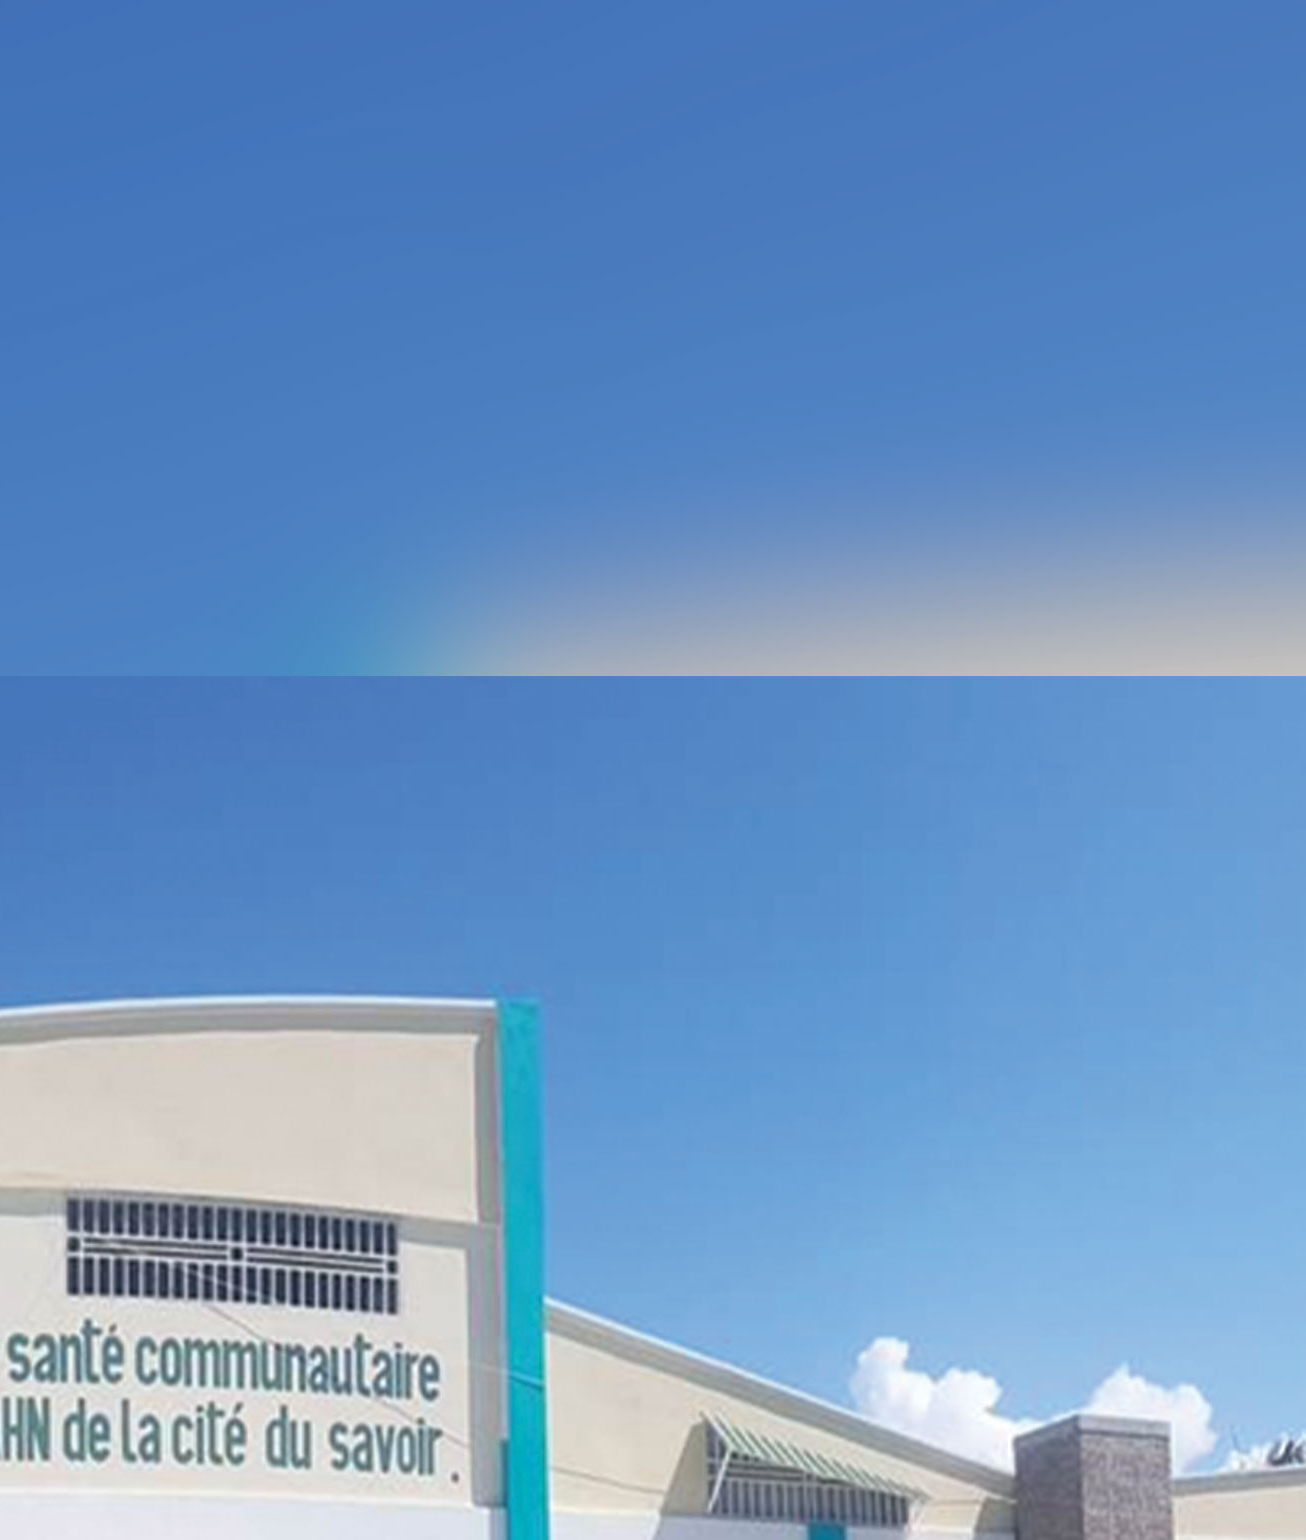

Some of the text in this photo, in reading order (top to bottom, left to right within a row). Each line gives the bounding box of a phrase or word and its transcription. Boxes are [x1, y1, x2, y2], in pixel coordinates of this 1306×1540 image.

[7, 1318, 125, 1383] santé
[134, 1335, 441, 1402] communautaire
[63, 1398, 111, 1463] de
[121, 1399, 161, 1465] la
[172, 1402, 247, 1467] cité
[266, 1406, 312, 1470] du
[329, 1418, 443, 1476] savoir
